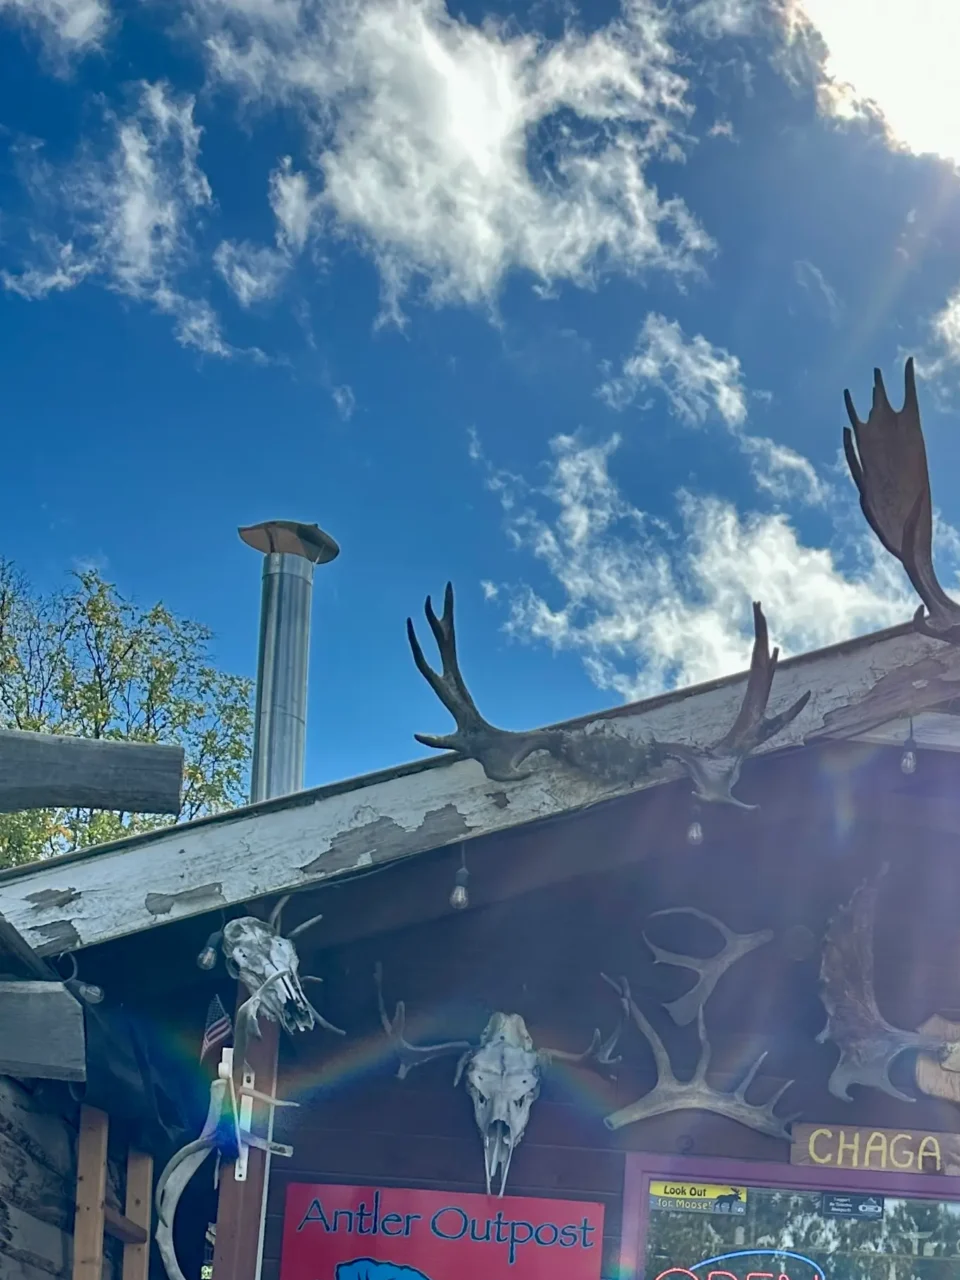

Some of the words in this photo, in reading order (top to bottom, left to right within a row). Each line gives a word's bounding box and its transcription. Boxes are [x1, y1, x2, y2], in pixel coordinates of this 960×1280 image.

[808, 1128, 941, 1172] CHAGA
[657, 1198, 673, 1208] for
[675, 1199, 712, 1210] Moose!
[663, 1185, 687, 1196] Look
[689, 1186, 707, 1197] Out
[297, 1190, 423, 1237] Antler
[429, 1206, 596, 1265] Outpost
